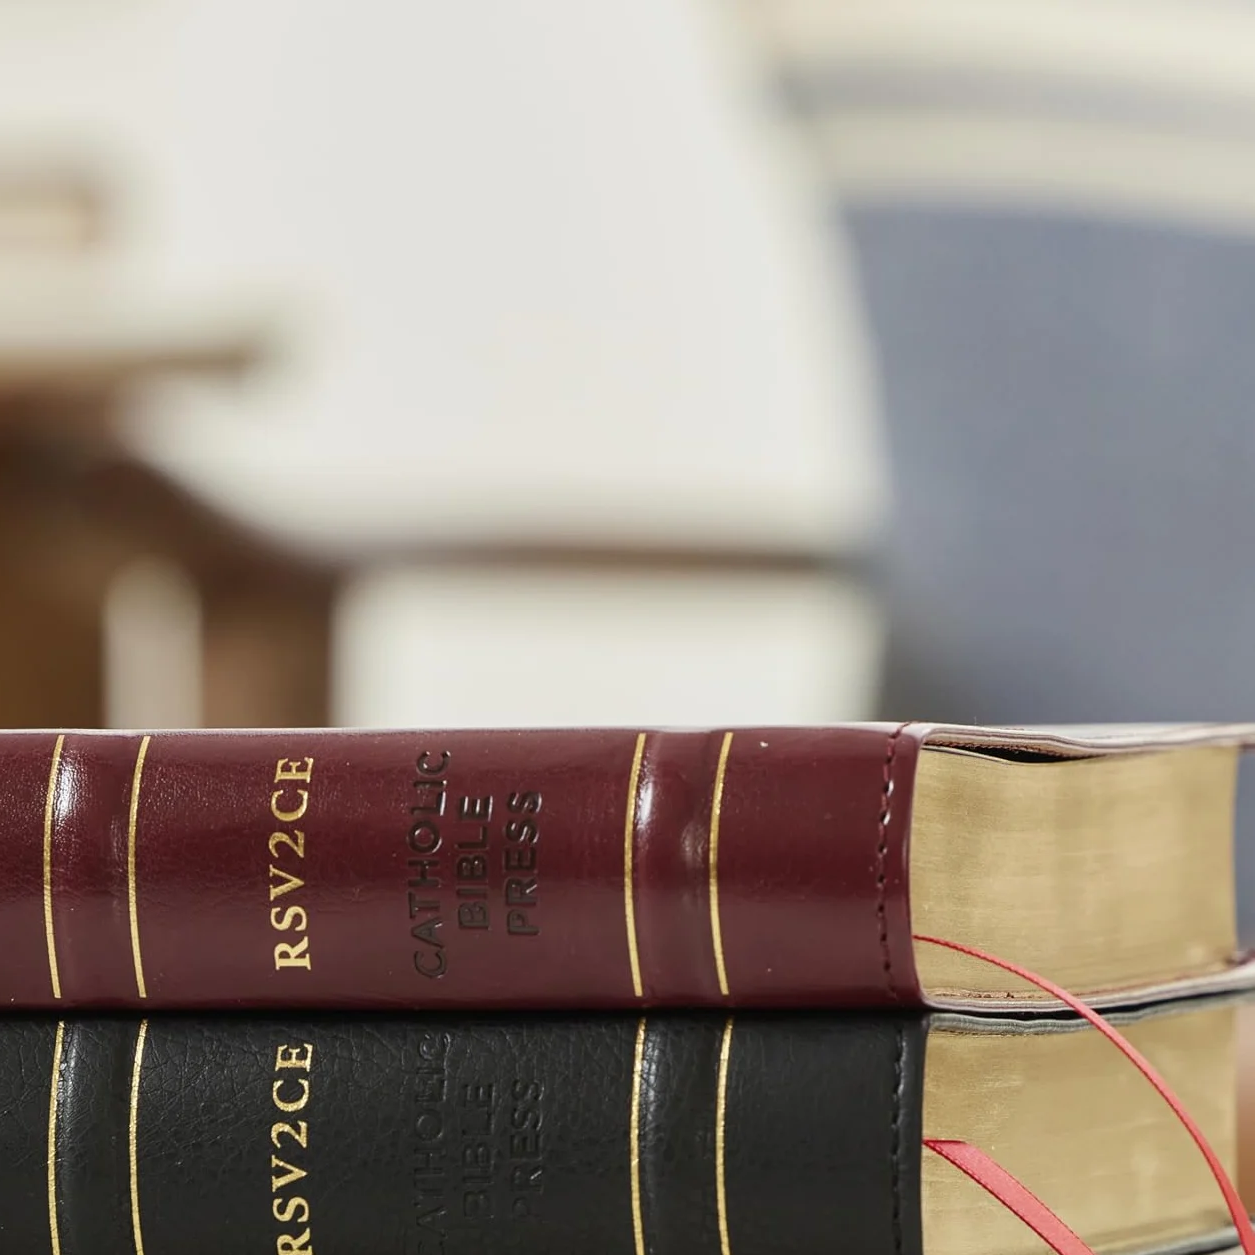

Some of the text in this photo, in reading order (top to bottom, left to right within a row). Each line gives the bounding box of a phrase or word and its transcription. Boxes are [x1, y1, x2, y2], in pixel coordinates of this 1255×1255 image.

[268, 757, 314, 971] RSV2CE
[407, 750, 451, 979] CATHOLIC
[456, 795, 493, 931] BIBLE
[504, 791, 542, 936] PRESS
[461, 1082, 495, 1220] BIBLE
